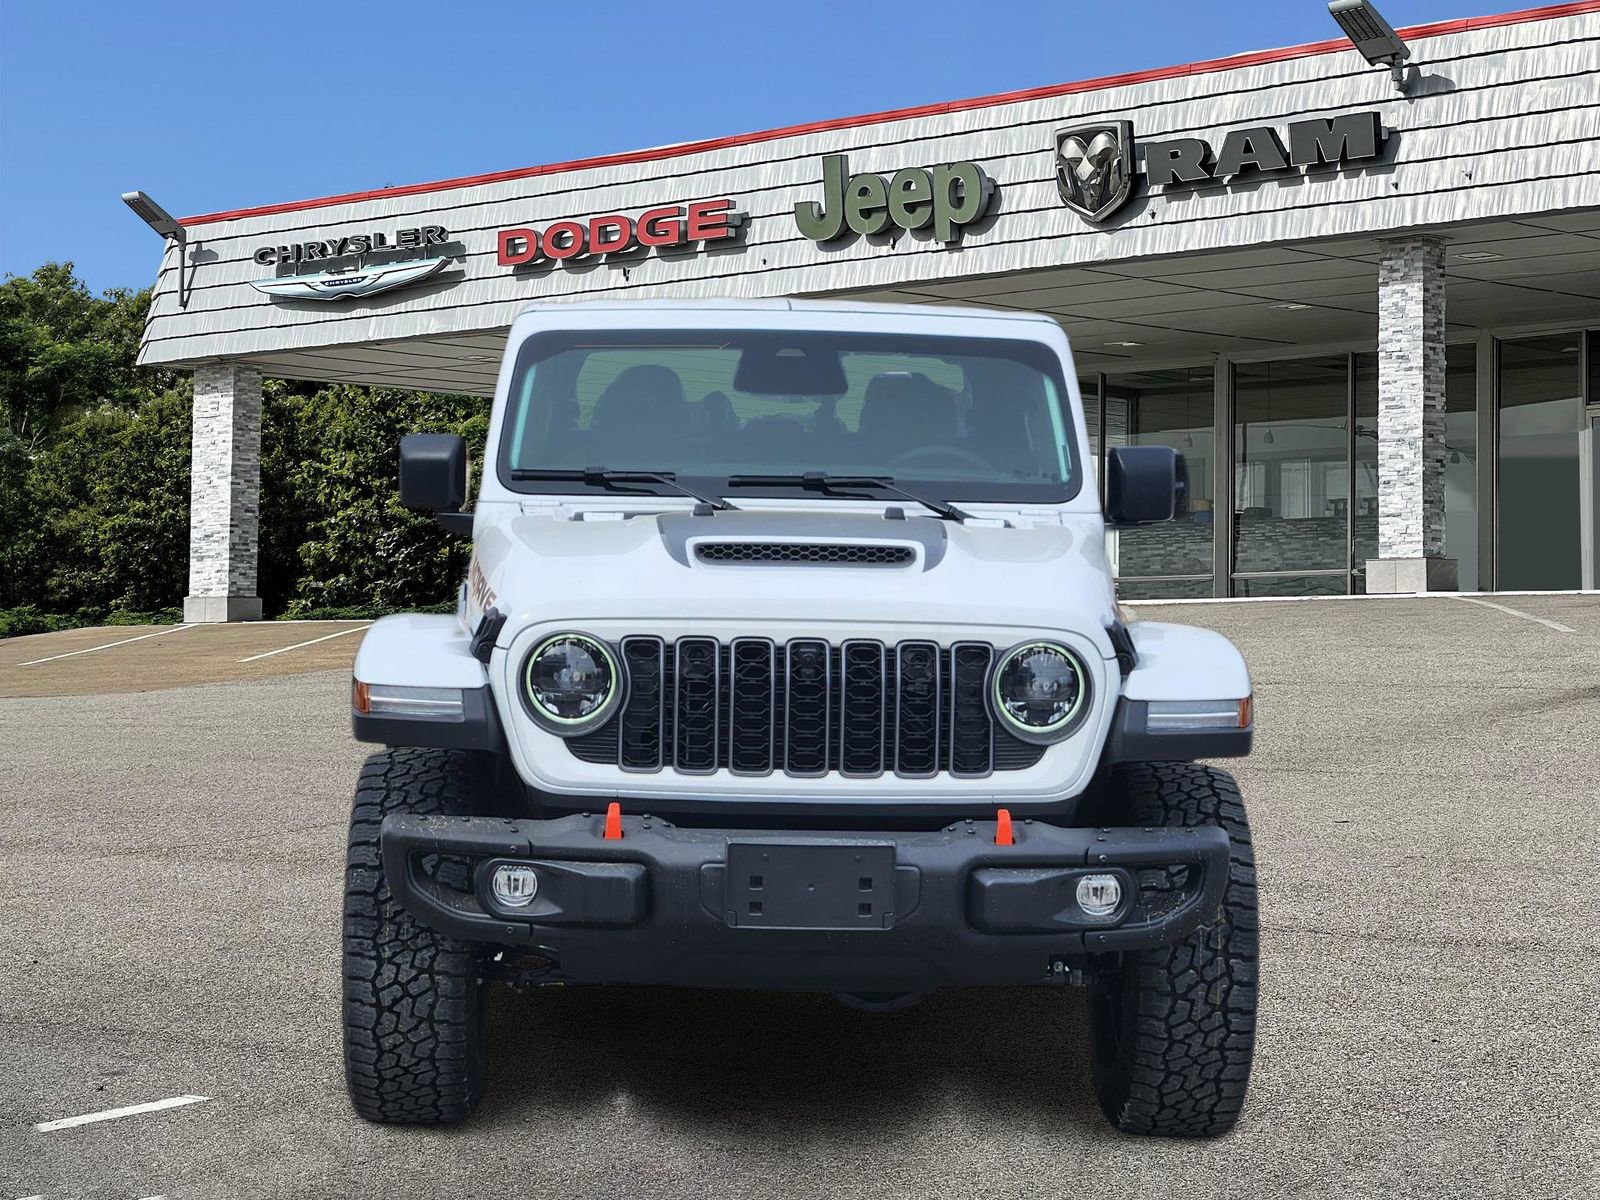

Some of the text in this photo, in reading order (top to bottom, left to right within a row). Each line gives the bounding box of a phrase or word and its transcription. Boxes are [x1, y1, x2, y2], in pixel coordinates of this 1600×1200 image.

[1144, 111, 1381, 186] RAM
[794, 154, 985, 242] Jeep
[253, 225, 449, 266] CHRYSLER
[498, 199, 735, 266] DODGE
[324, 277, 363, 287] CHRYSLER
